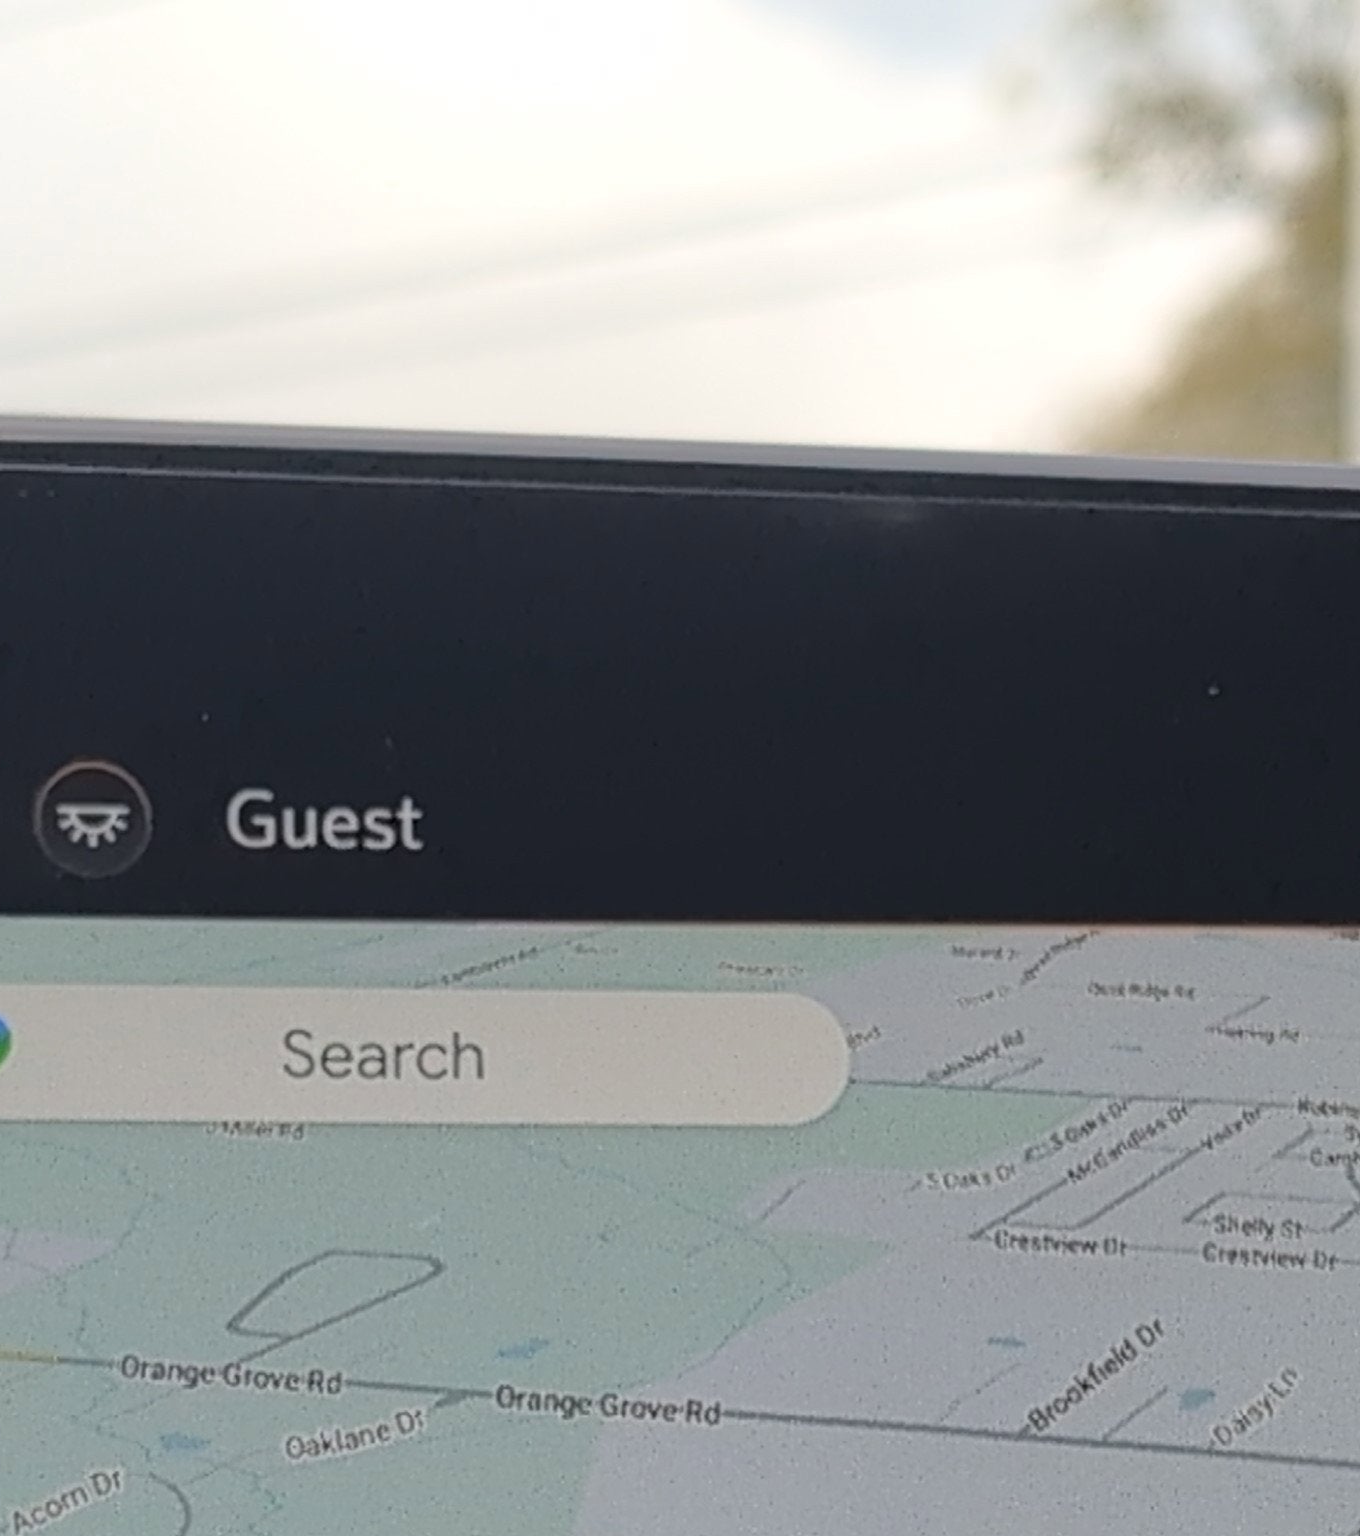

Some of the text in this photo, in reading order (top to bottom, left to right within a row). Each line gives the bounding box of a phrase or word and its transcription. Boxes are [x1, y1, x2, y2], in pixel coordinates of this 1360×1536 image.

[226, 788, 424, 852] Guest
[281, 1027, 486, 1082] Search
[993, 1227, 1128, 1256] Crestview Dr
[1212, 1212, 1303, 1242] Shelly St
[1201, 1240, 1338, 1271] Crestview Dr
[121, 1354, 343, 1395] Orange Grove Rd
[1026, 1317, 1168, 1434] Brookfield Dr
[495, 1385, 723, 1426] Orange Grove Rd
[1212, 1366, 1300, 1448] Daisy Ln
[285, 1408, 426, 1461] Oaklane Dr
[11, 1467, 124, 1536] Acorn Dr
